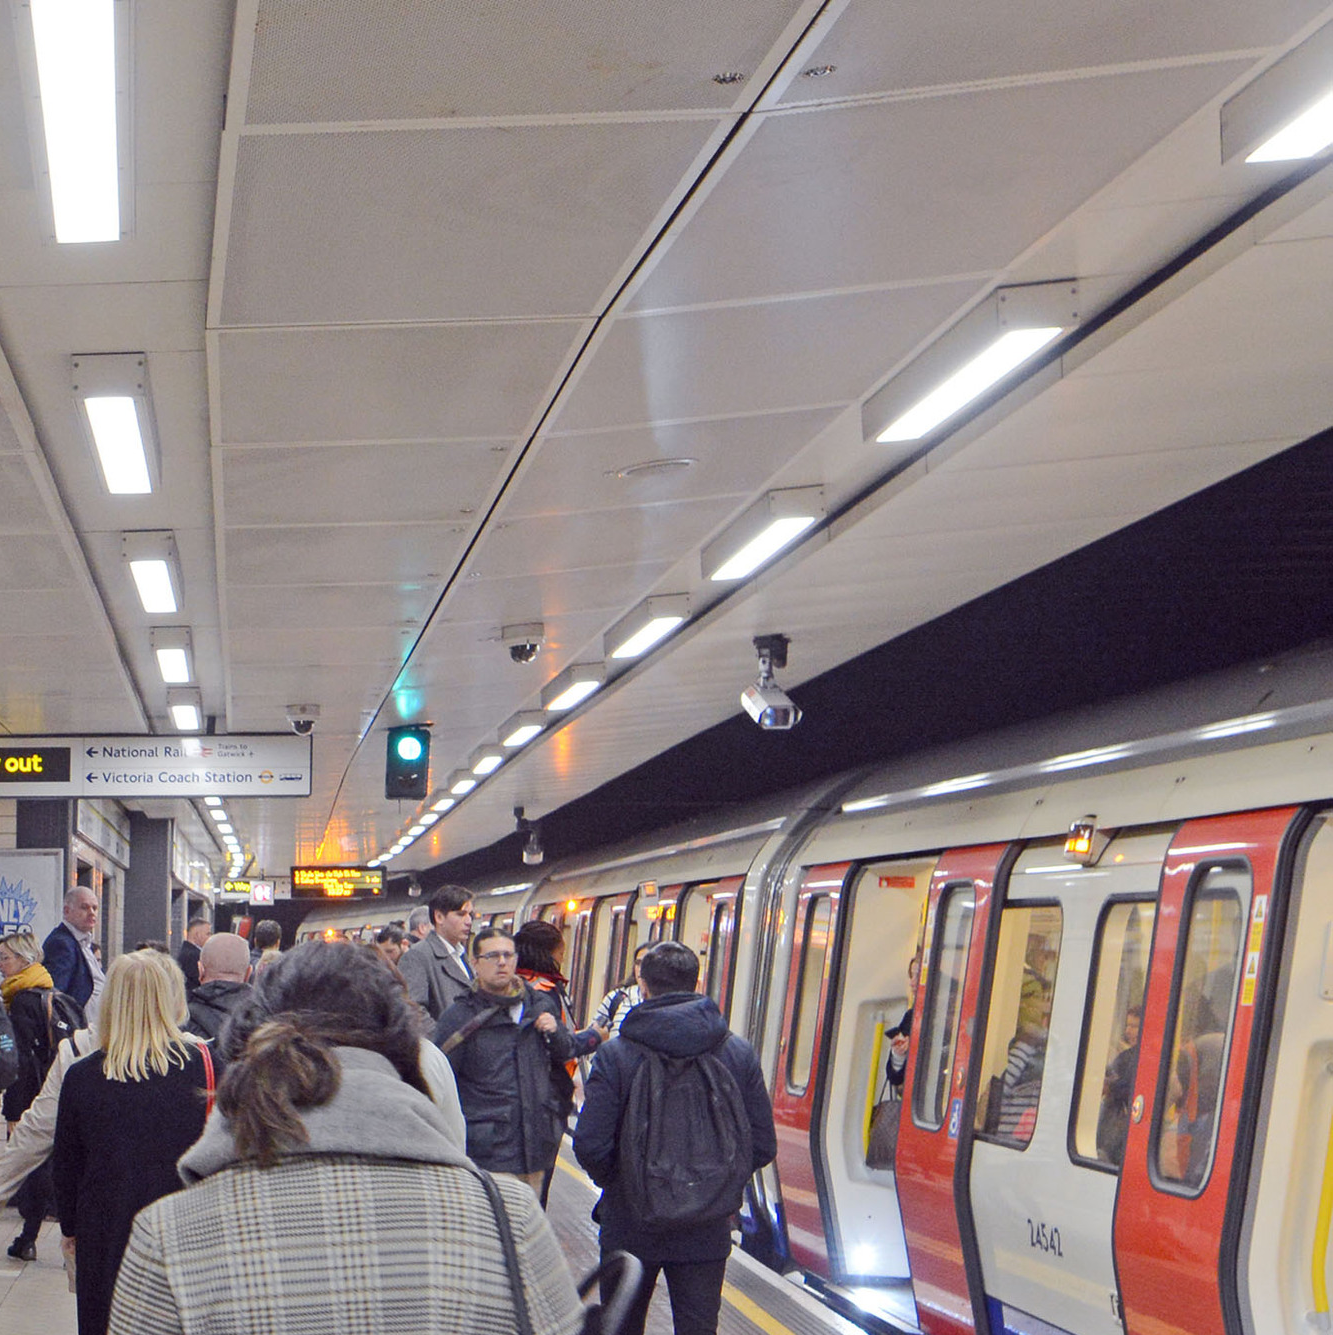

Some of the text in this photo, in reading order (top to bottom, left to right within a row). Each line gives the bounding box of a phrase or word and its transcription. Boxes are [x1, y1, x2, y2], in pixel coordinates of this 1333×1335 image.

[102, 746, 159, 758] National
[5, 754, 43, 773] out
[102, 772, 253, 783] Victoria Coach Station
[1027, 1218, 1063, 1257] 24542
